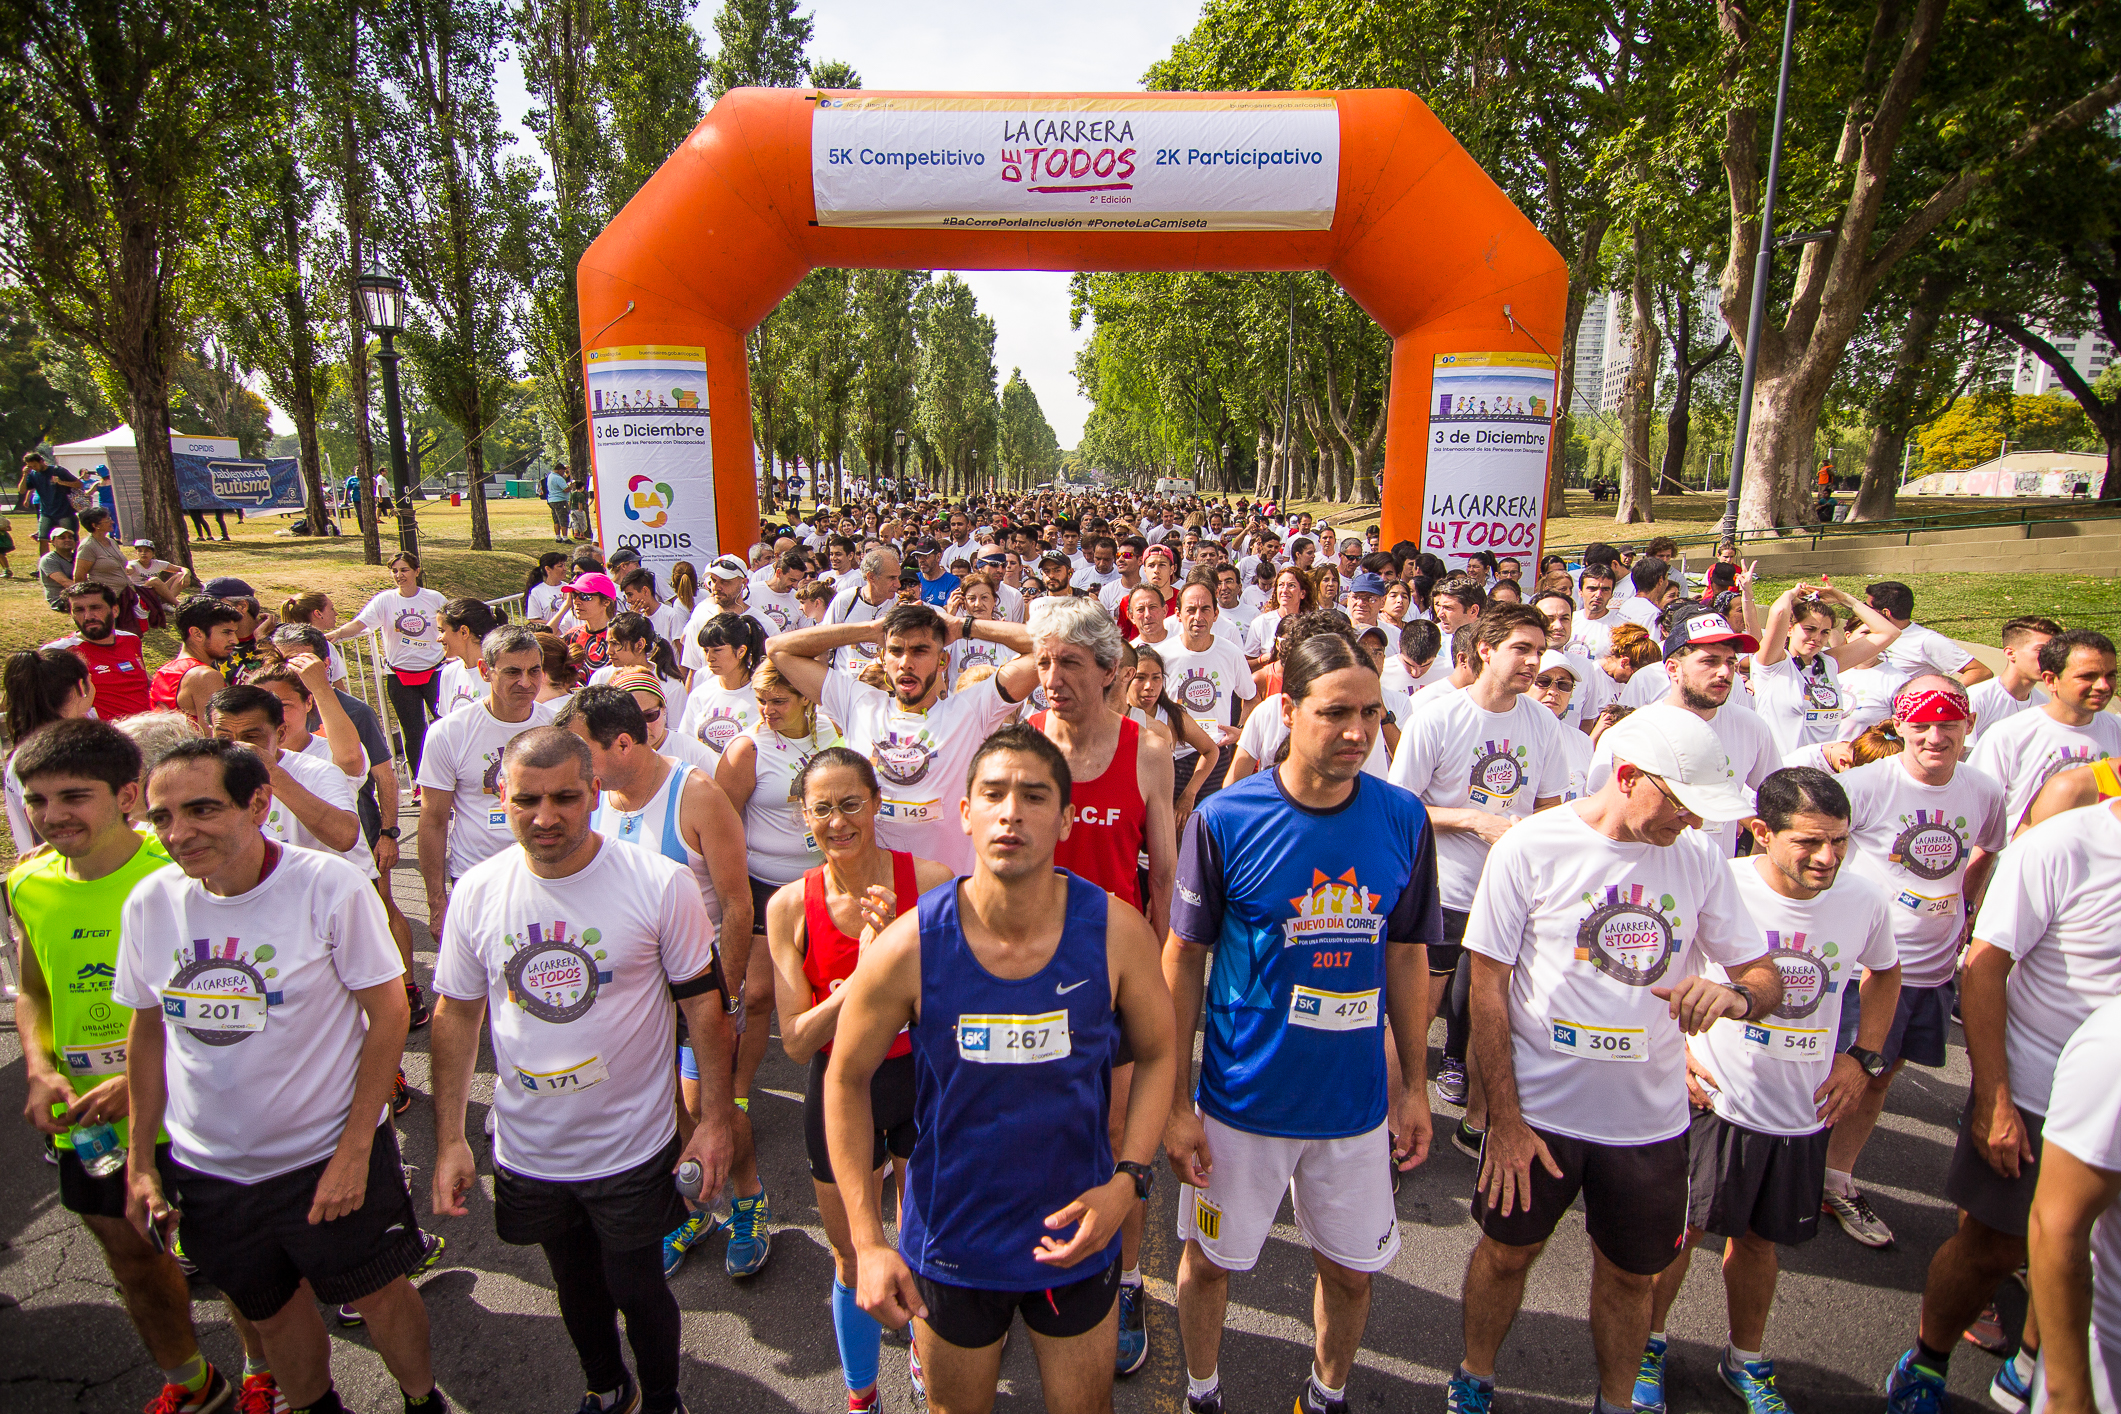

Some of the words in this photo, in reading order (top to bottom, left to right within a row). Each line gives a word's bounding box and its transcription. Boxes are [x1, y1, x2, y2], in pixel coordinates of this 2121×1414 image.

[829, 148, 854, 165] 5K
[860, 148, 986, 170] Competitivo
[1002, 148, 1022, 182] DE
[1025, 148, 1136, 181] TODOS
[1156, 148, 1181, 165] 2K
[1188, 148, 1323, 169] Participativo
[1101, 195, 1132, 204] Edición
[942, 217, 1082, 228] #BaCorrePorlaInclusión
[1087, 218, 1208, 229] #PoneteLaCamiseta
[597, 426, 603, 439] 3
[605, 424, 620, 438] de
[623, 422, 705, 437] Diciembre
[1435, 430, 1444, 443] 3
[1449, 429, 1471, 443] de
[1476, 430, 1545, 445] Diciembre
[189, 444, 215, 452] COPIDIS
[212, 468, 256, 480] hablemos
[214, 478, 270, 495] autismo
[618, 533, 692, 549] COPIDIS
[1427, 521, 1445, 549] DE
[1448, 521, 1537, 549] TODOS
[903, 807, 928, 818] 149
[1922, 843, 1953, 854] TODOS
[1902, 894, 1916, 906] 5K
[1927, 899, 1949, 912] 260
[1293, 918, 1325, 933] NUEVO
[1327, 915, 1345, 929] DÍA
[1346, 917, 1378, 930] CORRE
[1614, 931, 1659, 946] TODOS
[1313, 951, 1352, 968] 2017
[537, 967, 581, 985] TODOS
[1777, 966, 1816, 975] ARRERA
[1781, 975, 1816, 985] ODOS
[167, 1001, 181, 1013] 5K
[198, 1003, 241, 1020] 201
[1299, 999, 1316, 1011] 5K
[1334, 1000, 1368, 1017] 470
[82, 1022, 125, 1032] URBANICA
[964, 1031, 984, 1046] 5K
[1006, 1028, 1050, 1049] 267
[1557, 1029, 1571, 1041] 5K
[1589, 1035, 1631, 1051] 306
[1749, 1028, 1765, 1040] 5K
[1784, 1035, 1817, 1049] 546
[70, 1055, 86, 1066] 5K
[546, 1074, 579, 1089] 171
